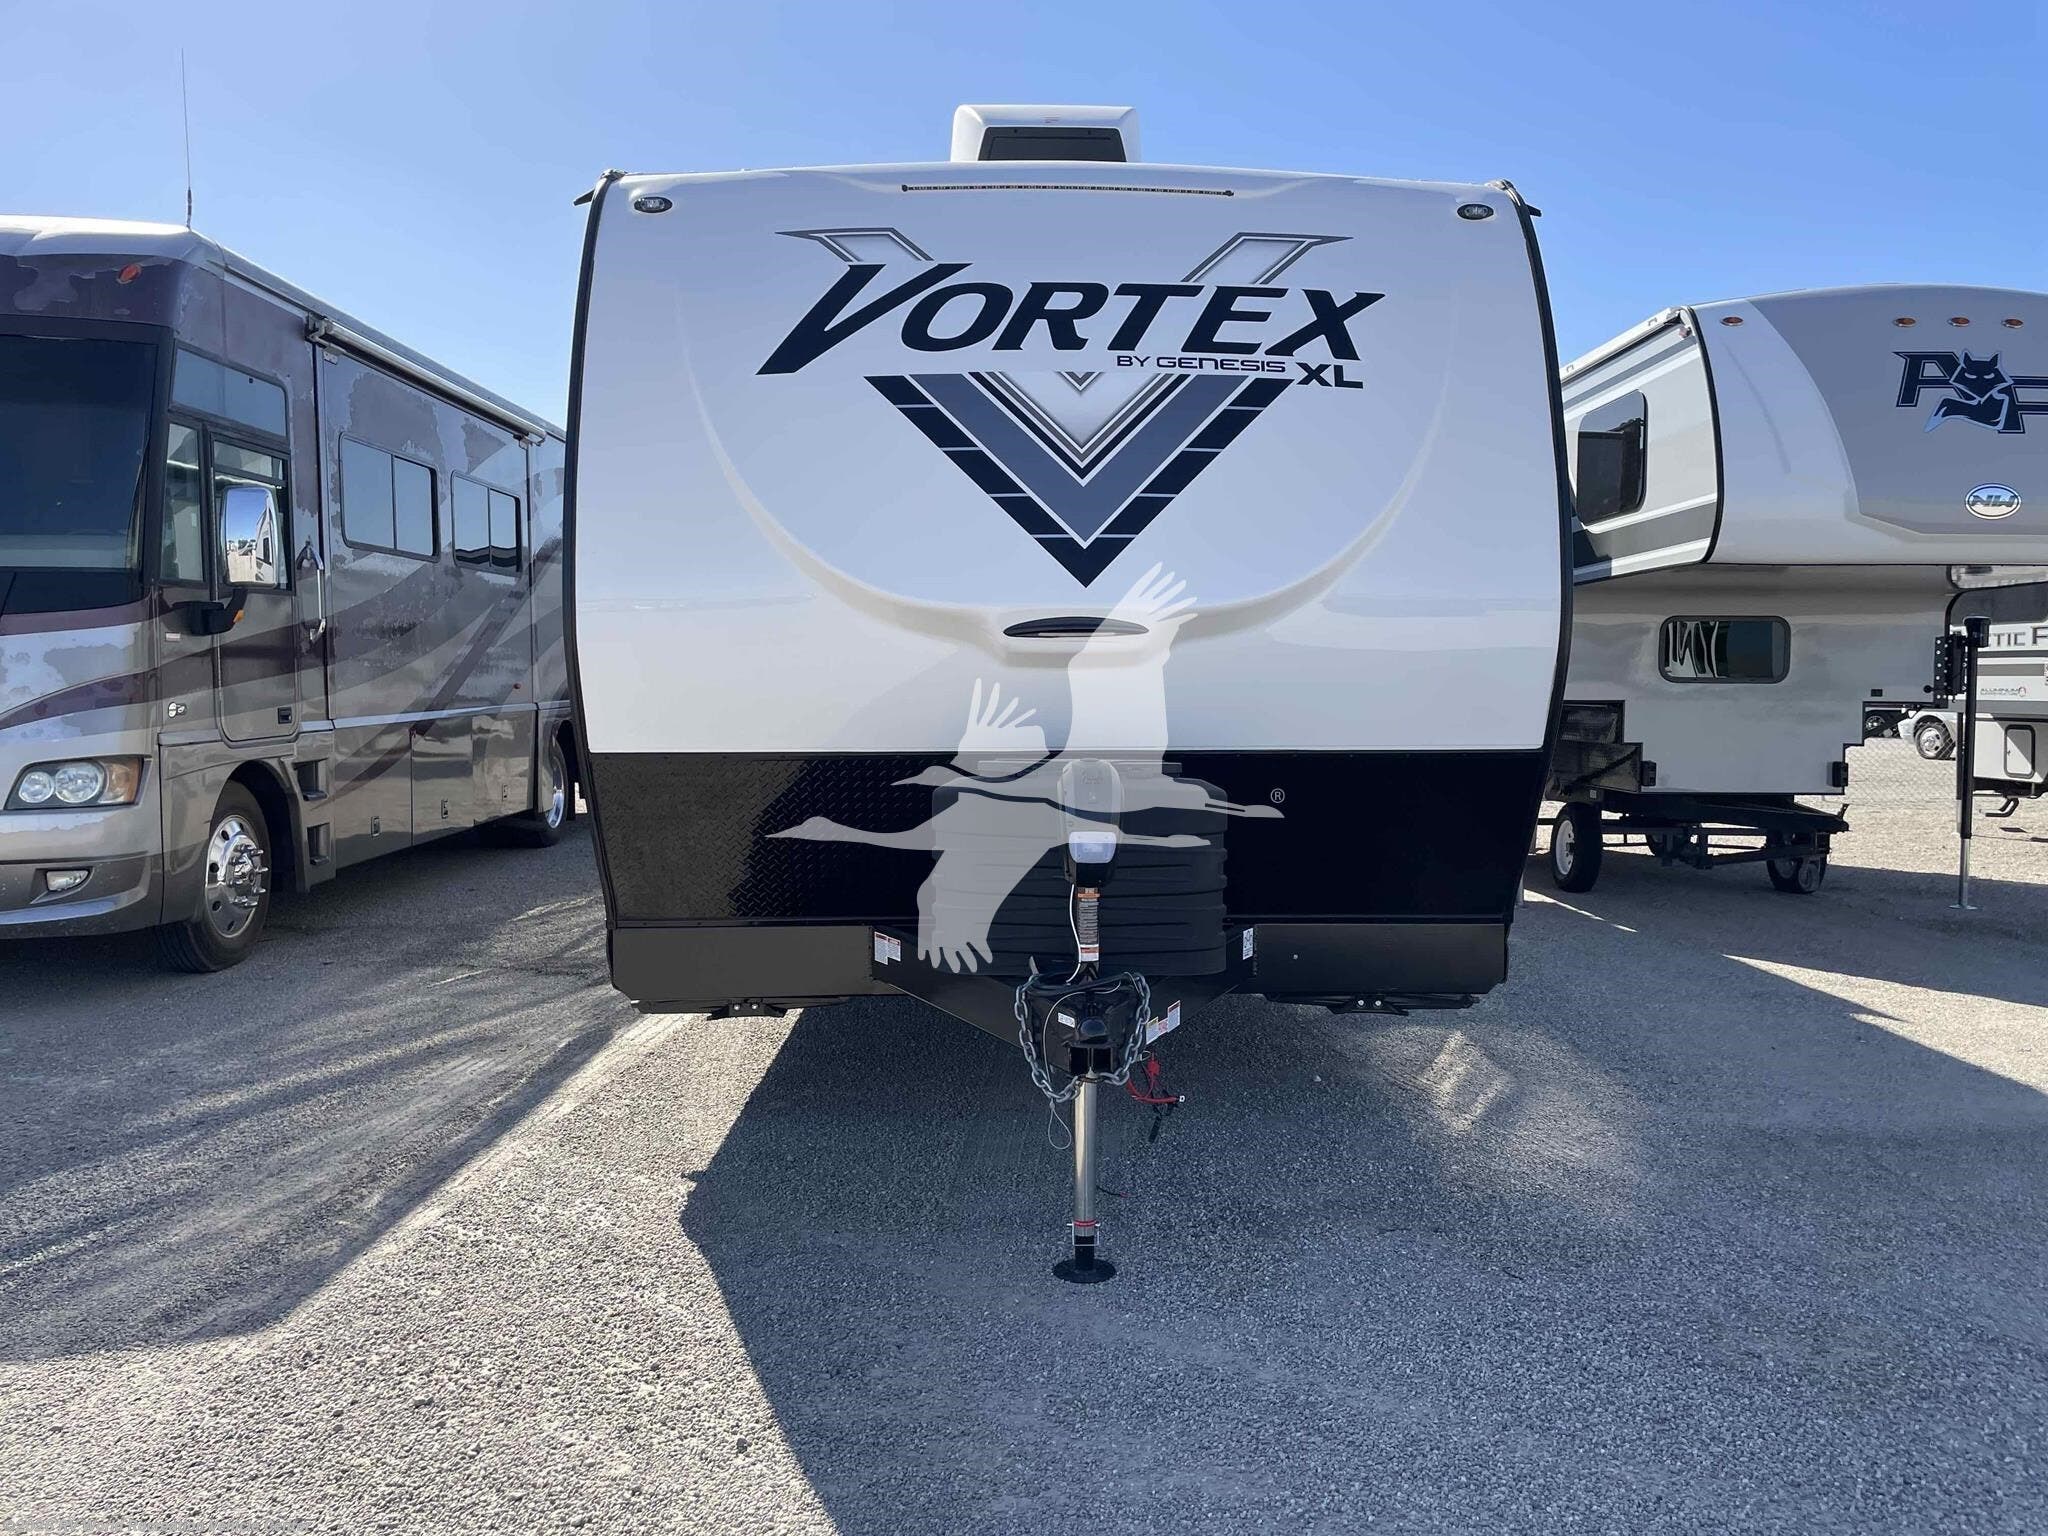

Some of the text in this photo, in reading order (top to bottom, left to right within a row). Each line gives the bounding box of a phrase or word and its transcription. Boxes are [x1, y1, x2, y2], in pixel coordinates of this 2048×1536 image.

[755, 263, 1385, 375] VORTEX
[1117, 355, 1364, 389] BY GENESIS XL
